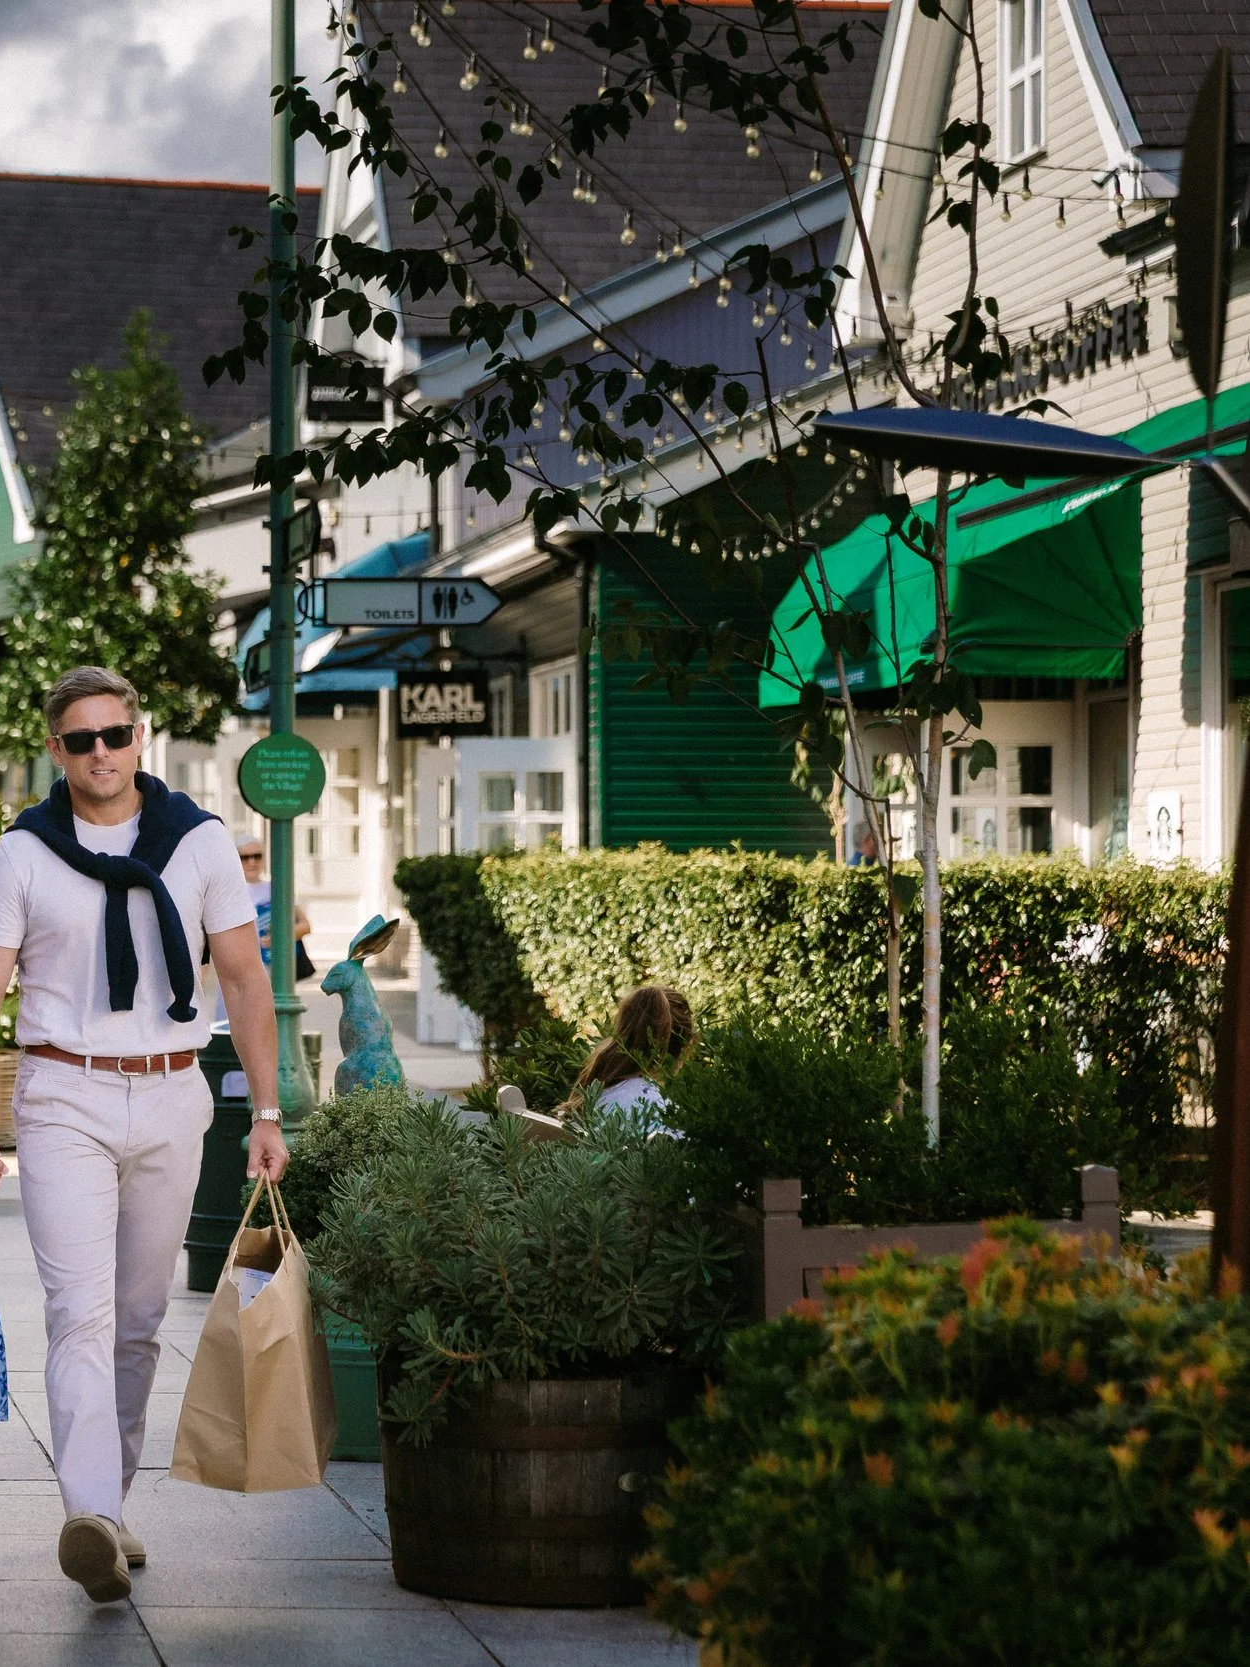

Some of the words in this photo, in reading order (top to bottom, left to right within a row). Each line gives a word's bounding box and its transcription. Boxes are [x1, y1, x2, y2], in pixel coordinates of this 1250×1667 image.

[364, 610, 415, 620] TOILETS
[401, 684, 485, 712] KARL
[401, 711, 485, 725] LAGERFELD
